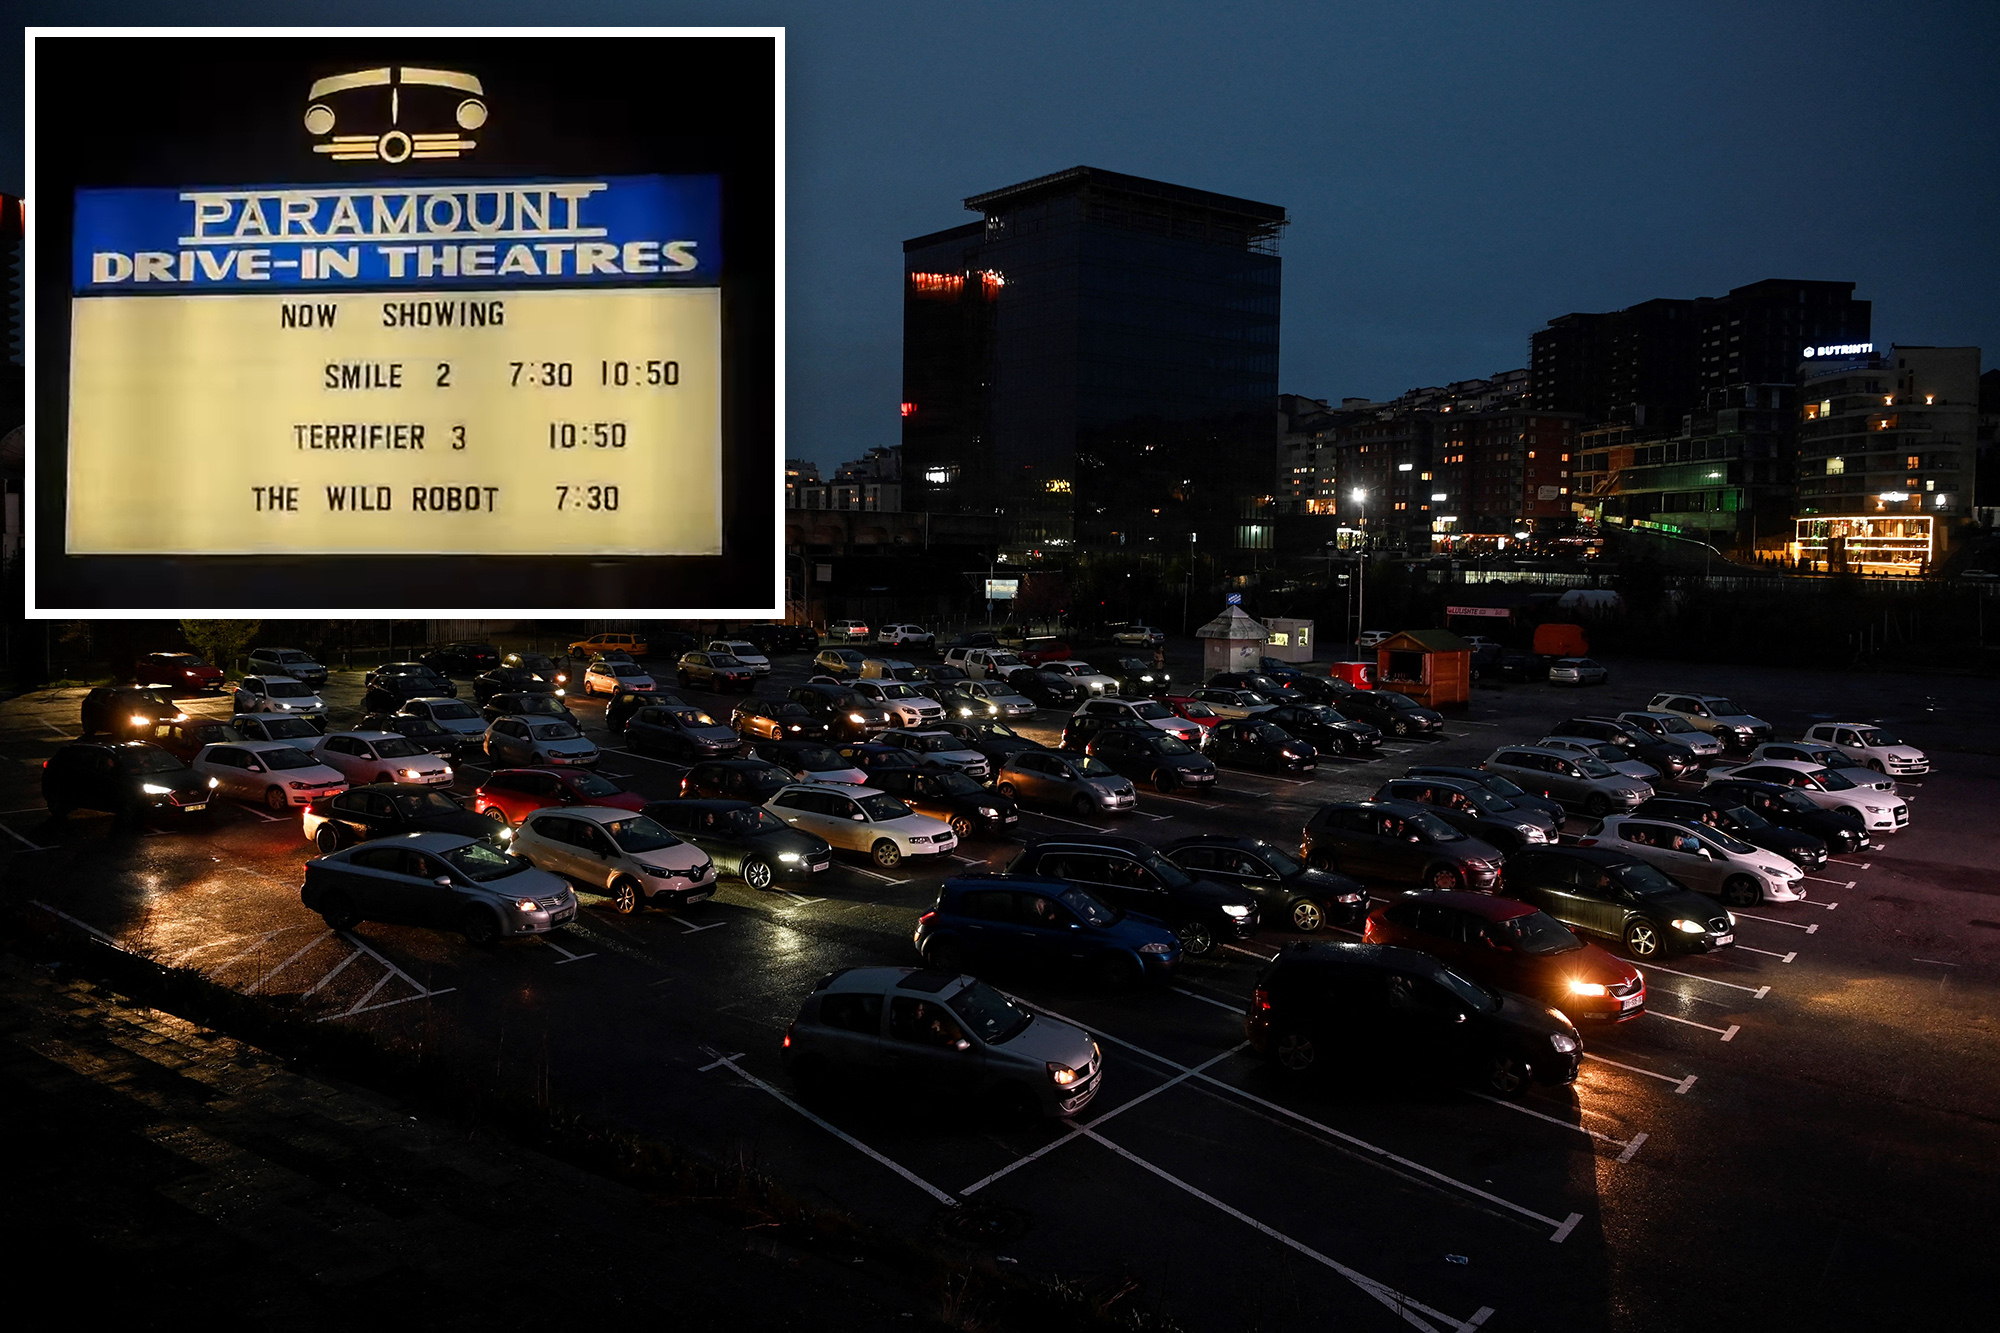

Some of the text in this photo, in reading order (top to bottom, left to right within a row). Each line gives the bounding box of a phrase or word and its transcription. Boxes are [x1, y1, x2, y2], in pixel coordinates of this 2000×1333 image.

[194, 190, 590, 238] PARAMOUNT
[92, 241, 698, 283] DRIVE-IN THEATRES
[281, 301, 504, 329] NOW SHOWING
[1817, 343, 1873, 356] BUTRINTI
[325, 360, 679, 389] SMILE 2 7:30 10:50
[294, 423, 626, 450] TERRIFIER 3 10:50
[251, 486, 618, 512] THE WILD ROBOT 7:30
